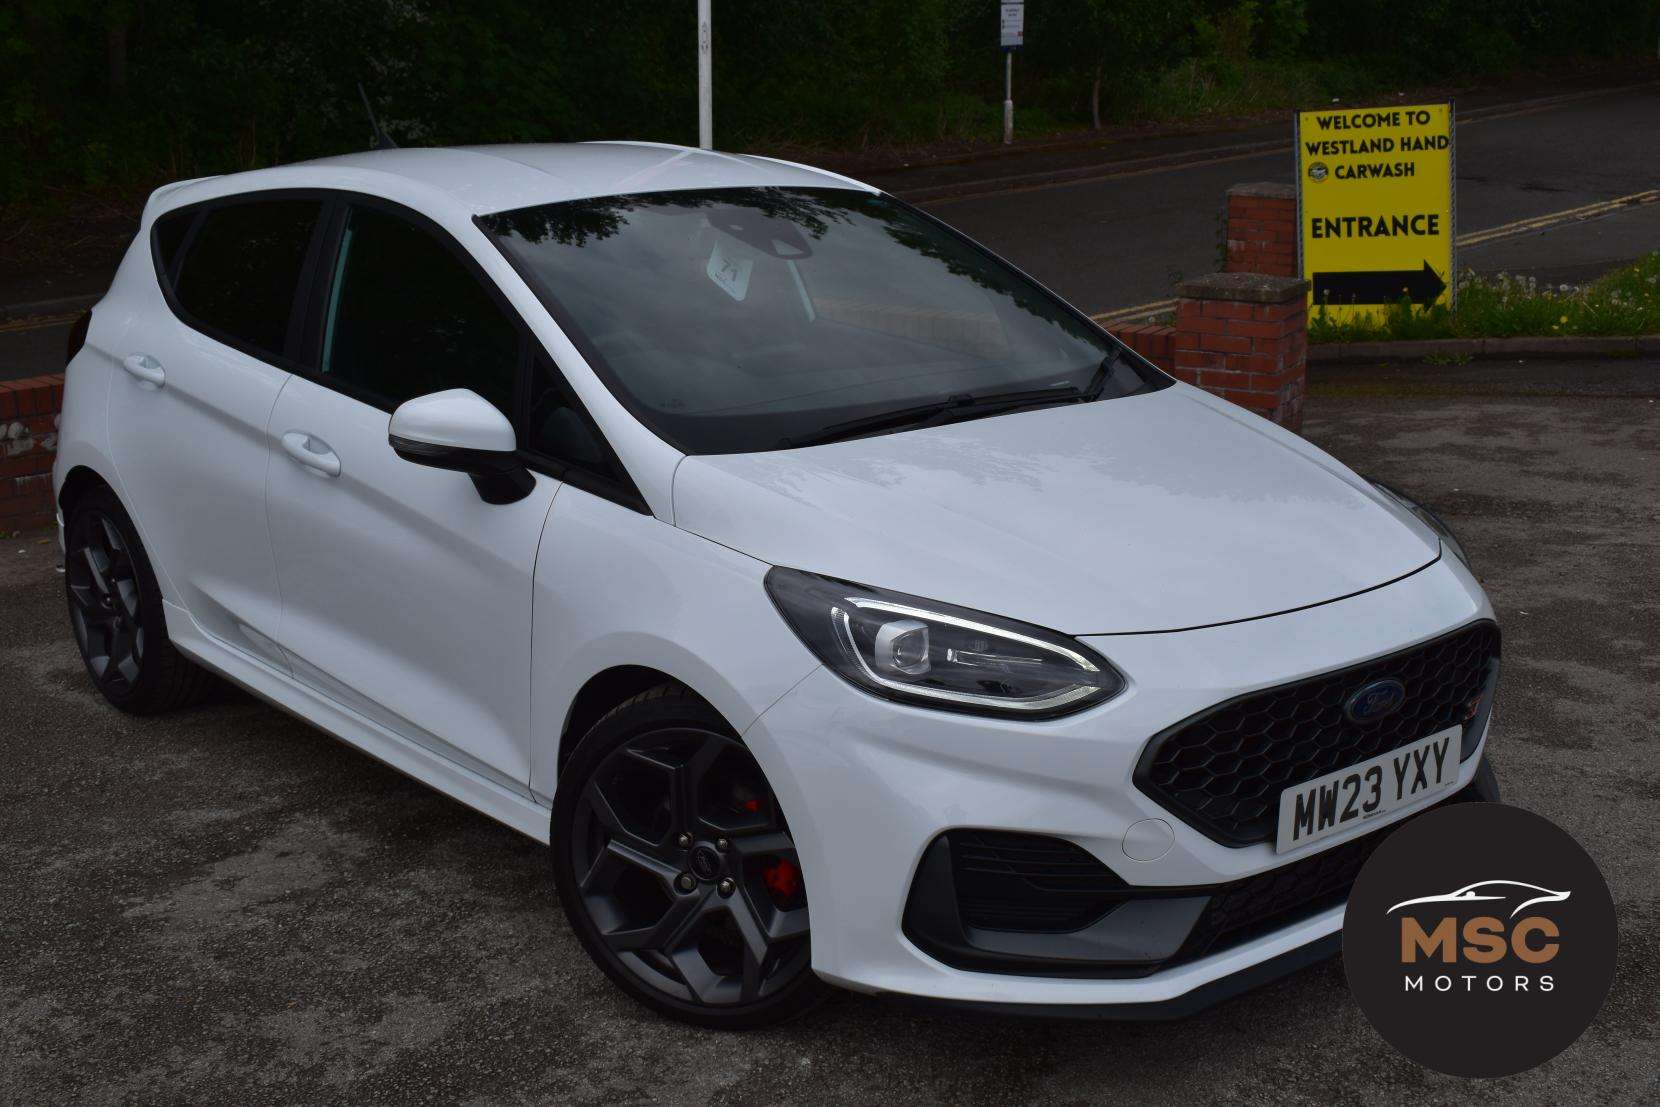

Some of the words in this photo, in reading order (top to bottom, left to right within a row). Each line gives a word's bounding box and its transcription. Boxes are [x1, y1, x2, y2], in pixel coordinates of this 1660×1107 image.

[1316, 112, 1400, 130] WELCOME
[1405, 110, 1431, 126] TO
[1305, 138, 1394, 156] WESTLAND
[1400, 135, 1449, 152] HAND
[1334, 161, 1415, 179] CARWASH
[1311, 214, 1440, 239] ENTRANCE
[1293, 765, 1383, 841] MW23
[1393, 737, 1450, 801] YXY
